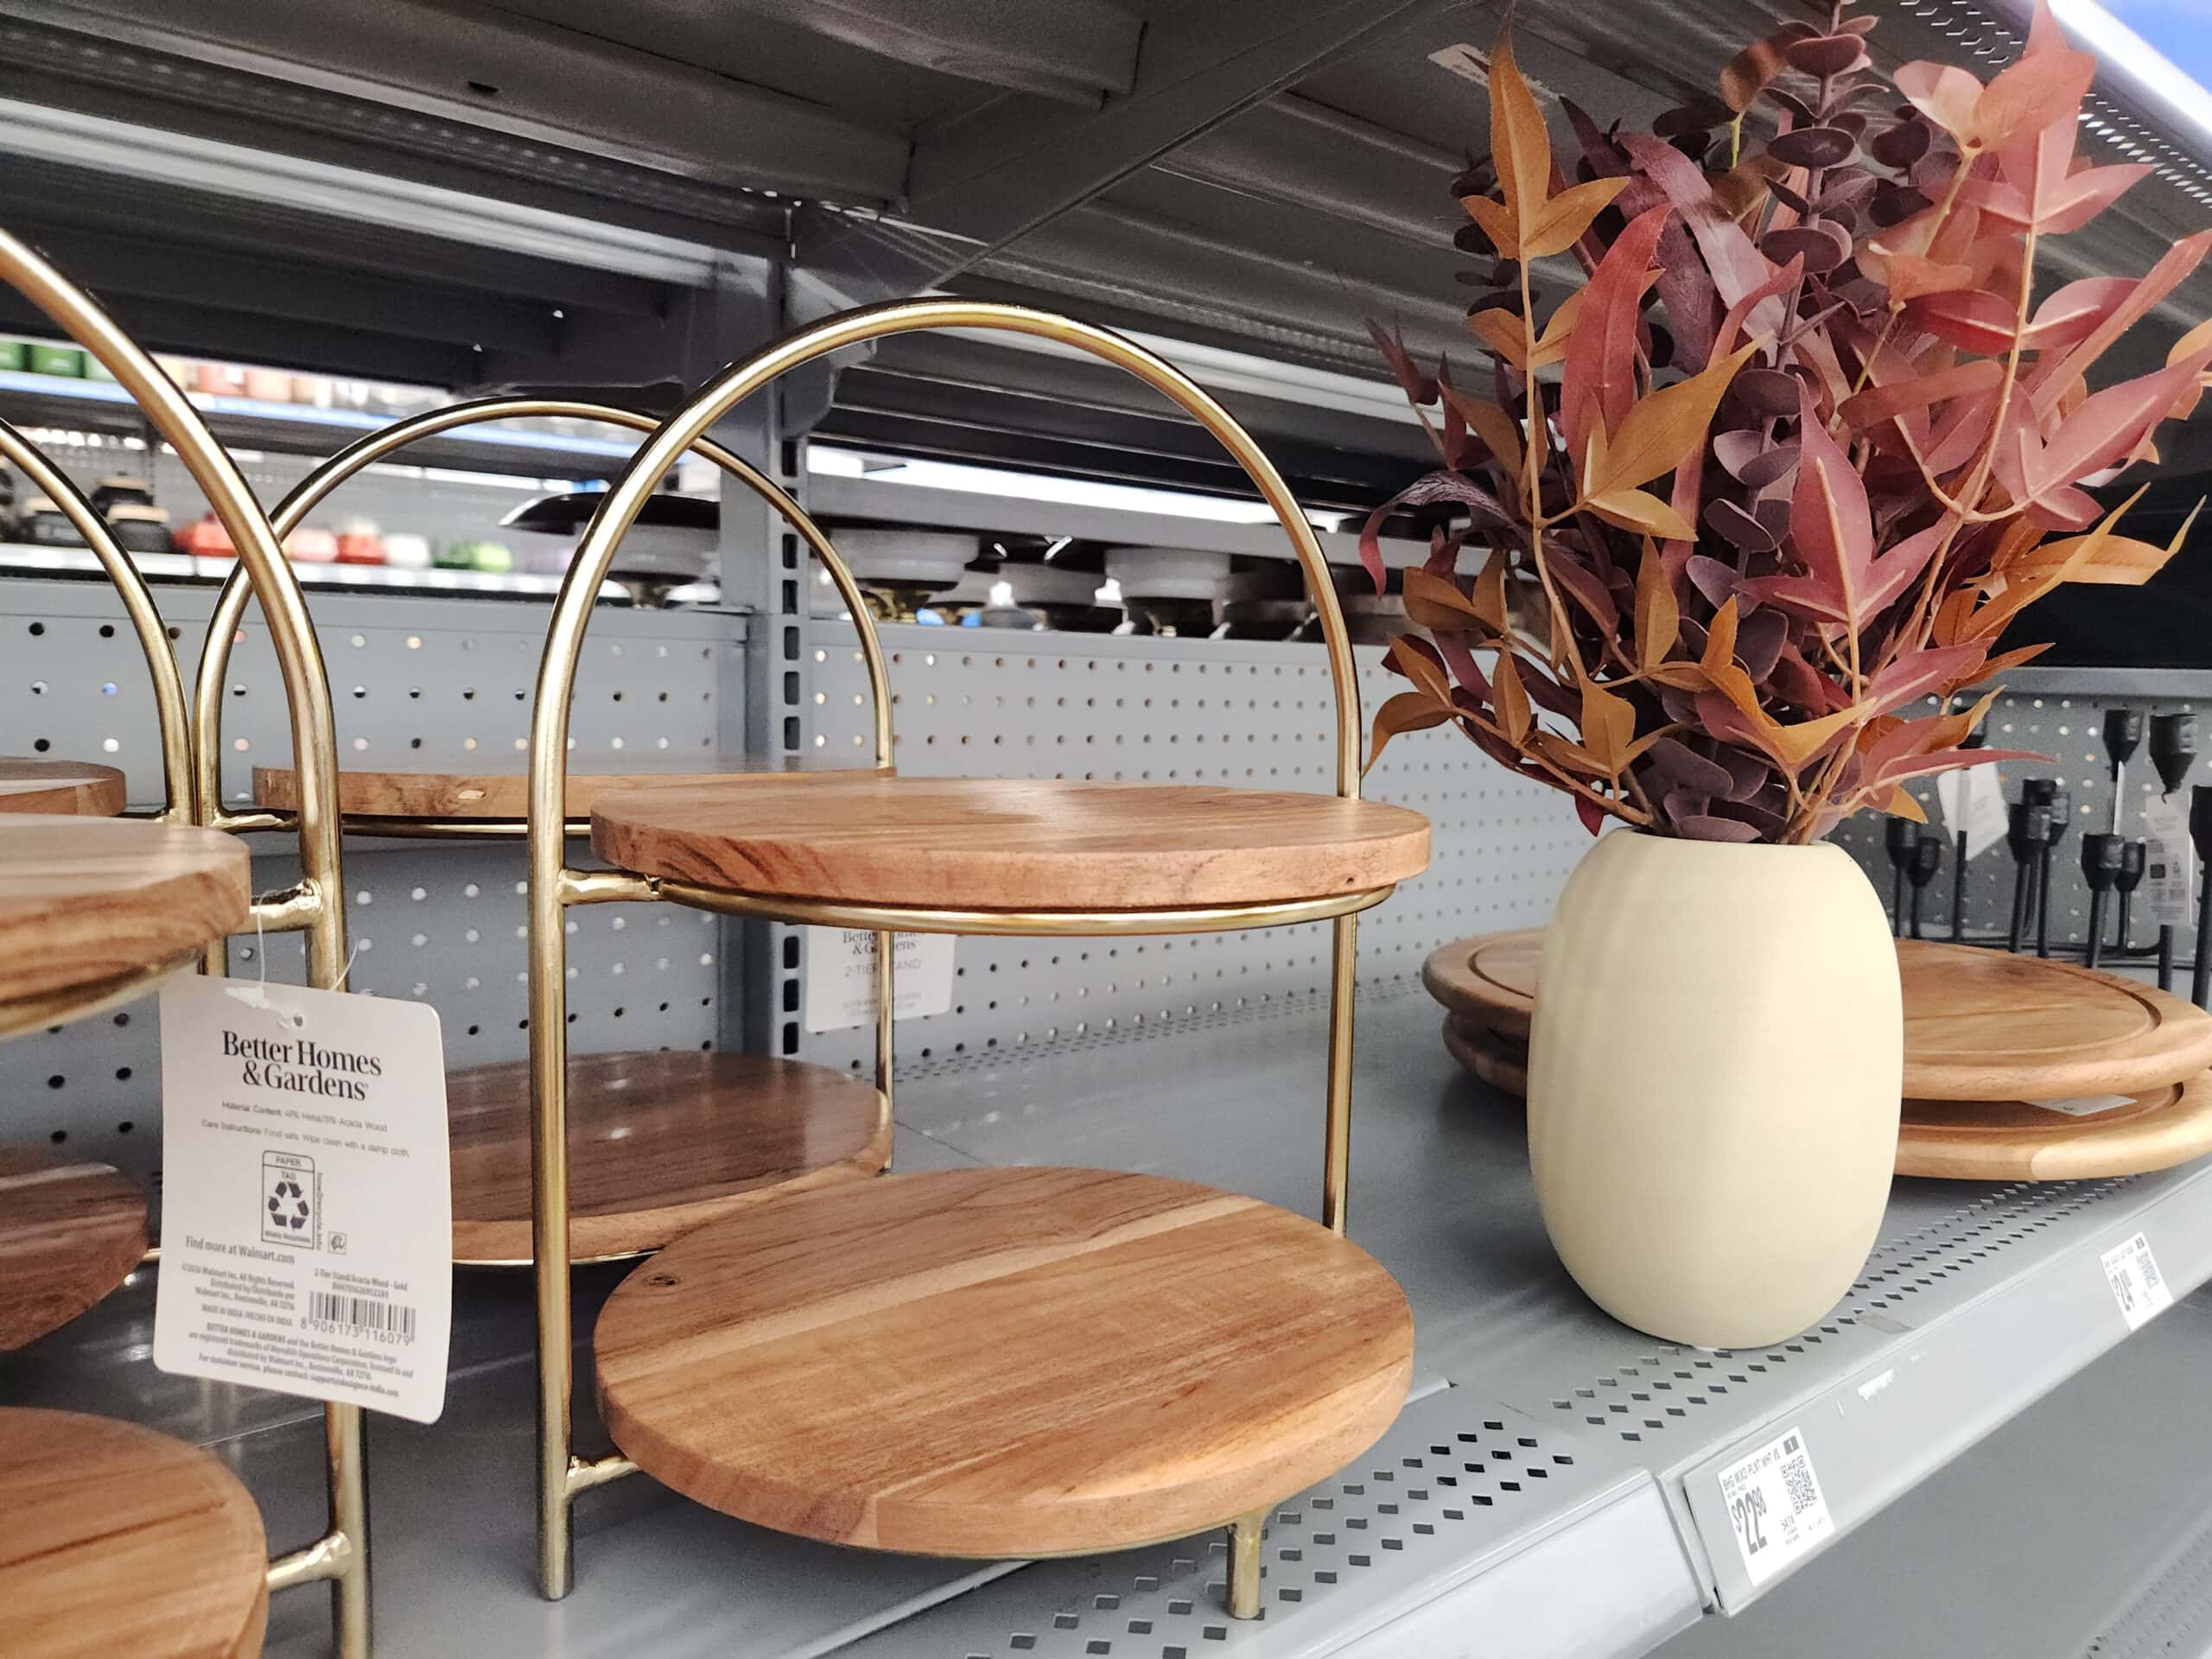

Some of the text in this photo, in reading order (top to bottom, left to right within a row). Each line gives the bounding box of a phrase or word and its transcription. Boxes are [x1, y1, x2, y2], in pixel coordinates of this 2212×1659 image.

[222, 1030, 382, 1076] Better Homes
[243, 1060, 366, 1101] & Gardens
[365, 1120, 387, 1132] Wood
[302, 1134, 321, 1144] Wipe
[345, 1140, 359, 1149] with
[276, 1156, 301, 1167] PAPER
[281, 1171, 296, 1180] TAG
[186, 1236, 295, 1264] Find more at Walmart.com
[207, 1322, 228, 1333] BETTER
[230, 1327, 251, 1338] HOMES
[257, 1331, 286, 1343] GARDENS
